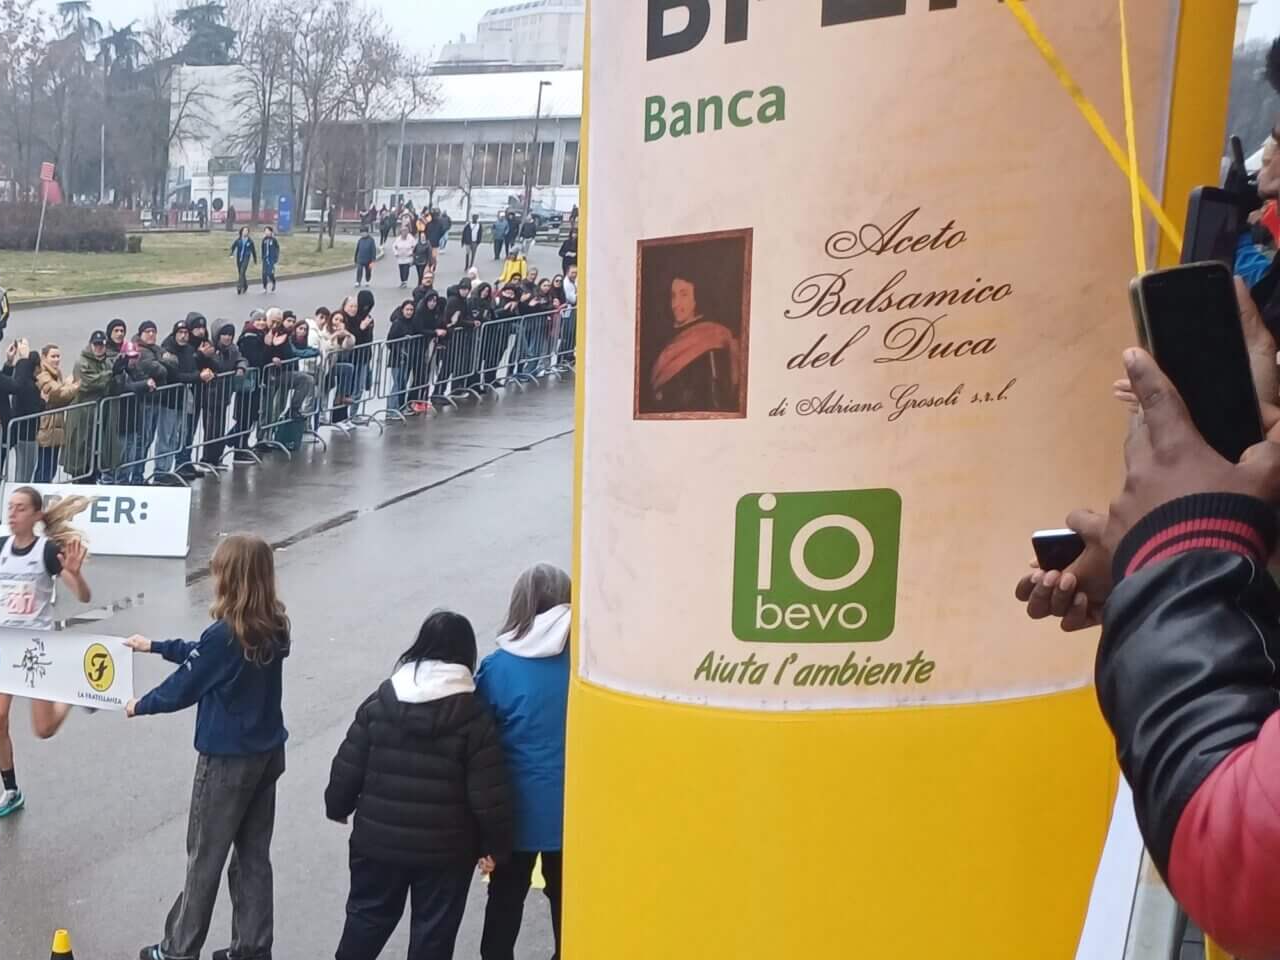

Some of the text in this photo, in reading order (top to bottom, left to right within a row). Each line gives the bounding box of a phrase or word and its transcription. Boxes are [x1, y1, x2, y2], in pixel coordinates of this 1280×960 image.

[644, 84, 786, 142] Banca
[824, 206, 968, 260] Aceto
[783, 268, 1013, 320] Balsamico
[786, 314, 998, 370] del Duca
[768, 397, 789, 417] di
[795, 389, 884, 416] Adriano
[887, 384, 965, 422] Grosoli
[757, 493, 875, 592] io
[755, 595, 868, 631] bevo
[694, 650, 936, 688] Aiuta l'ambiente
